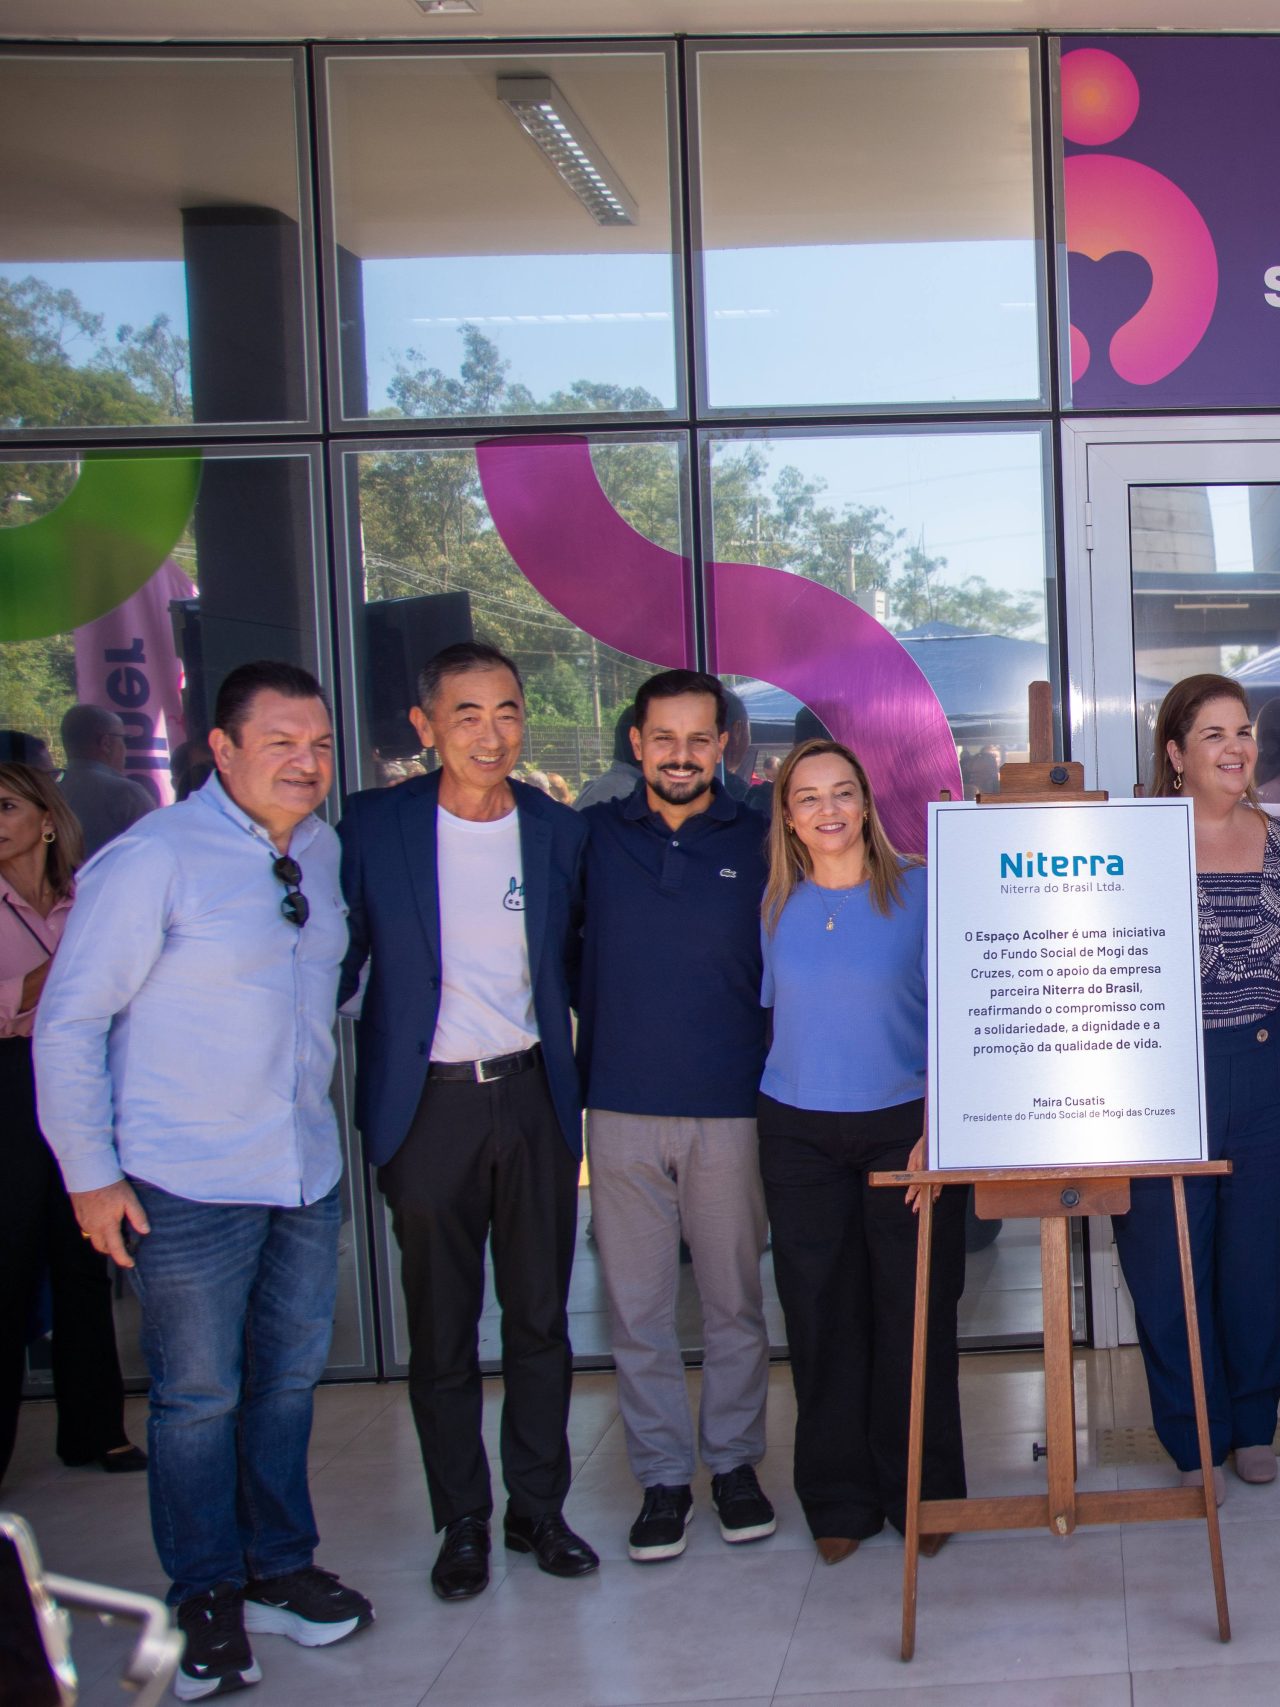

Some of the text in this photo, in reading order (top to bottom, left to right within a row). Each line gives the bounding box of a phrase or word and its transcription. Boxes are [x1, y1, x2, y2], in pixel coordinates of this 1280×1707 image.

[1001, 852, 1123, 878] Niterra
[1001, 882, 1124, 893] Niterra do Brasil Ltda.
[965, 927, 1165, 943] O Espaço Acolher é uma iniciativa
[983, 946, 1148, 959] do Fundo Social de Mogi das
[971, 969, 1014, 978] Cruzes,
[1018, 969, 1043, 977] com
[1057, 966, 1089, 978] apoio
[1093, 965, 1106, 975] da
[1110, 965, 1161, 978] empresa
[991, 983, 1142, 999] parceira Niterra do Brasil,
[969, 1004, 1041, 1016] reafirmando
[1056, 1002, 1136, 1017] compromisso
[1140, 1003, 1165, 1011] com
[975, 1027, 981, 1035] a
[985, 1023, 1067, 1034] solidariedade,
[1072, 1024, 1078, 1032] a
[1082, 1020, 1140, 1033] dignidade
[974, 1038, 1161, 1056] promoção da qualidade de vida.
[1034, 1096, 1105, 1107] Maira Cusatis
[963, 1113, 1012, 1121] Presidente
[1015, 1112, 1026, 1120] do
[1029, 1111, 1056, 1120] Fundo
[1059, 1110, 1086, 1118] Social
[1103, 1109, 1123, 1118] Mogi
[1145, 1108, 1175, 1116] Cruzes
